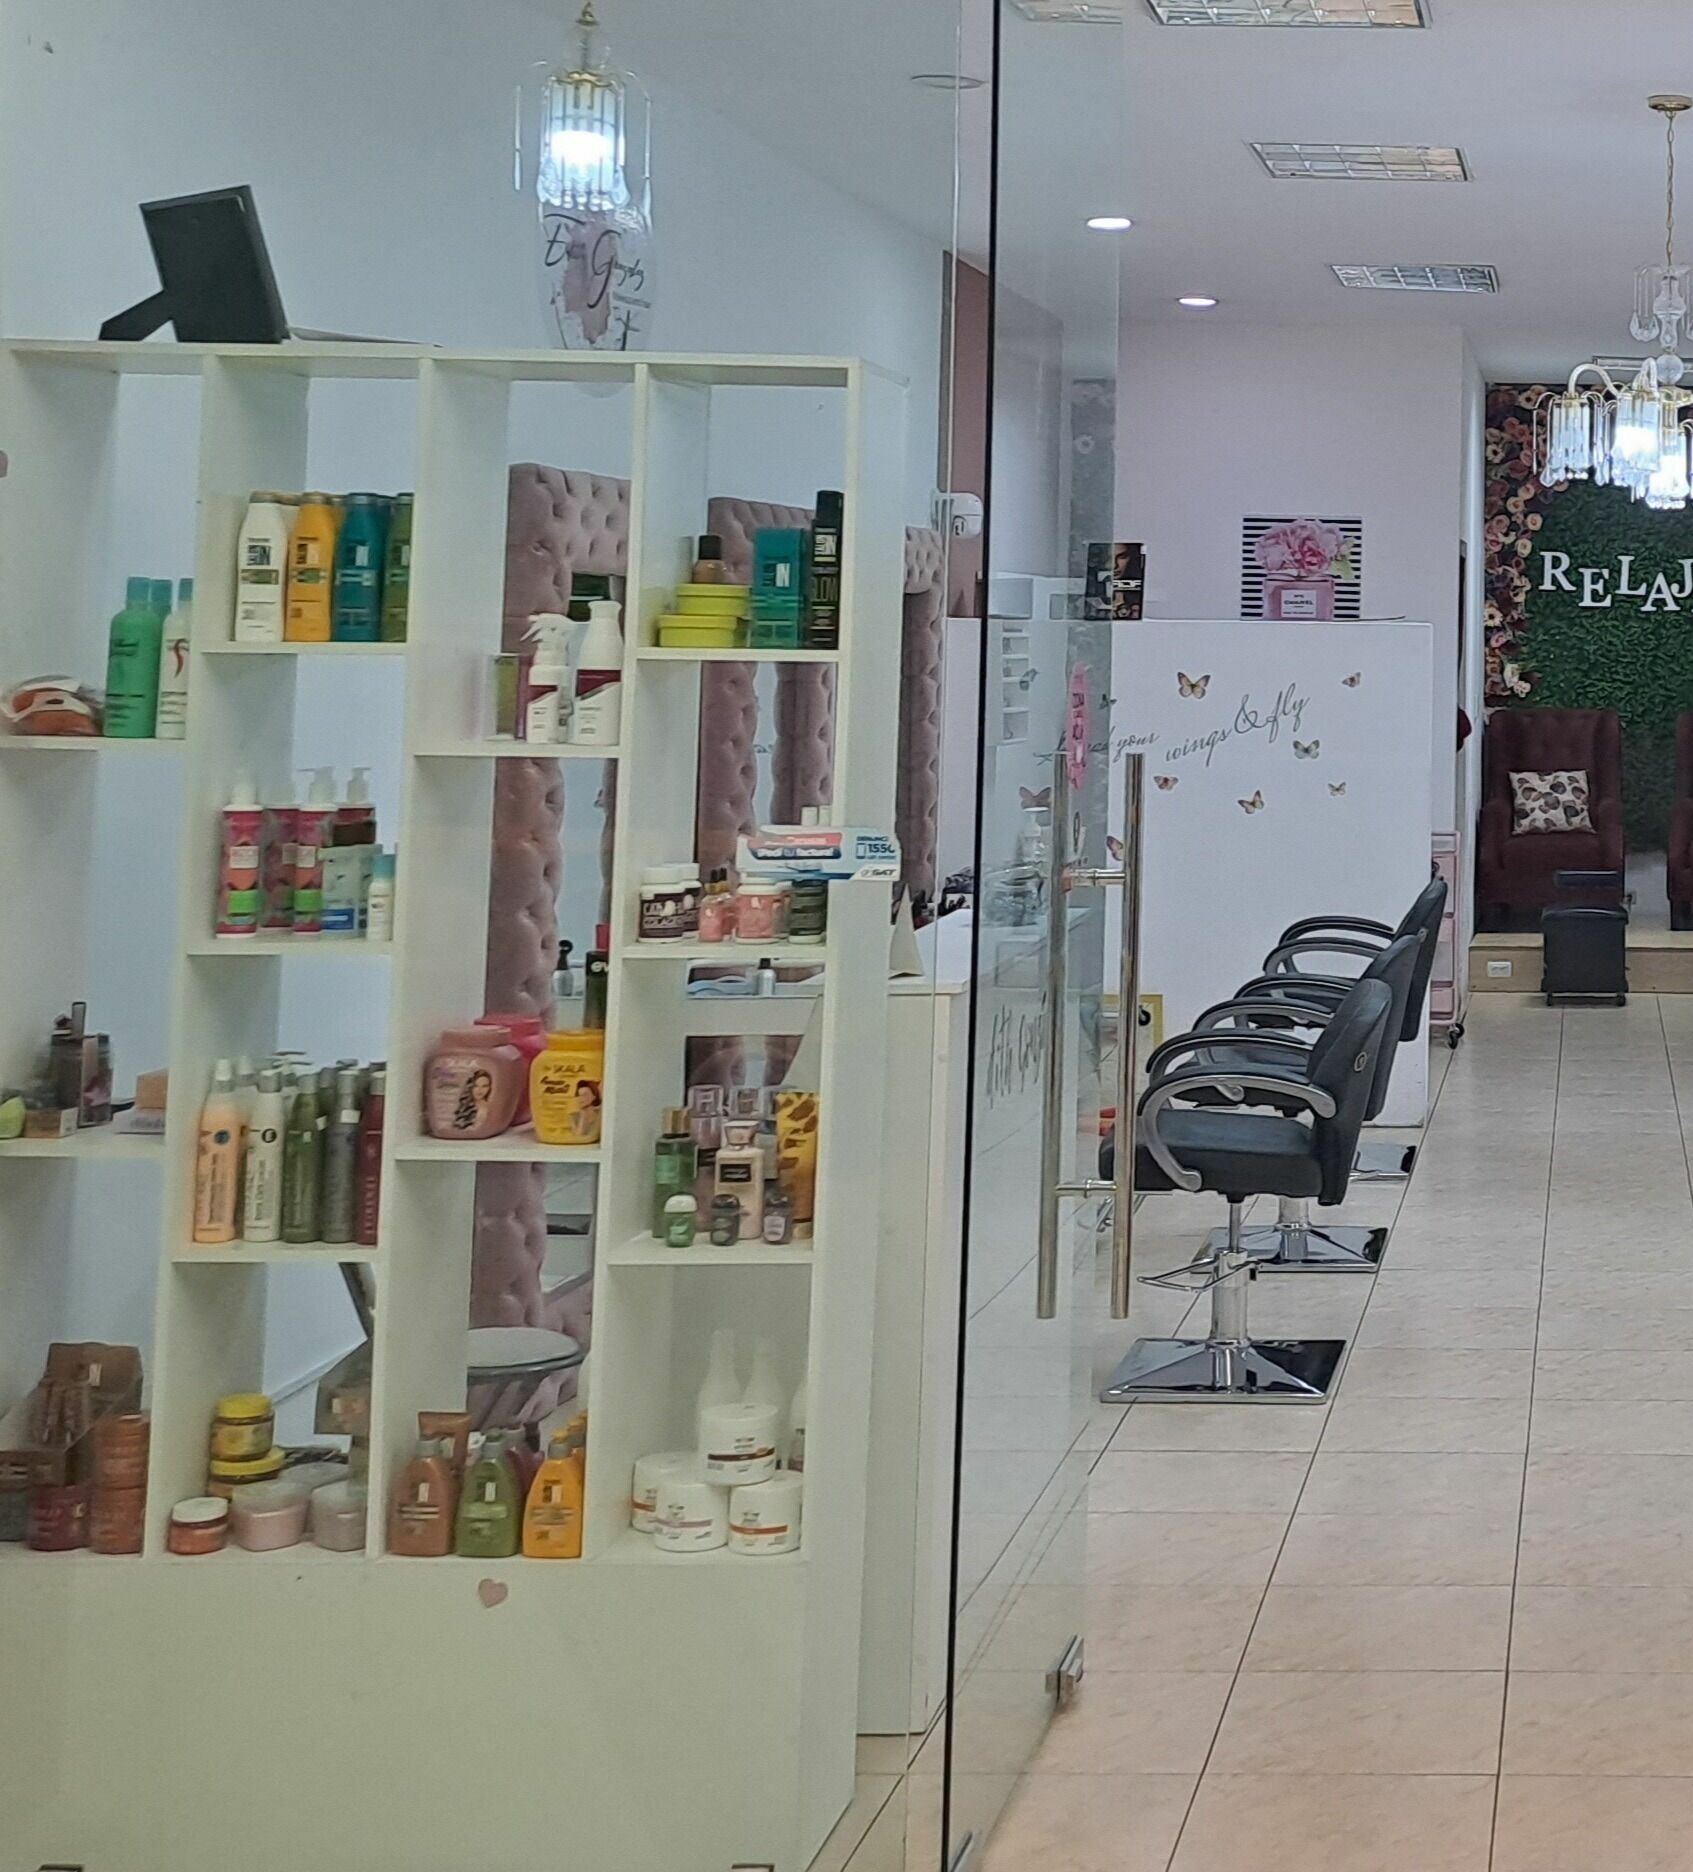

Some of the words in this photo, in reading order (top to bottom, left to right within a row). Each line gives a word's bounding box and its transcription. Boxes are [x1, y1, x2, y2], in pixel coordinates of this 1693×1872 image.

[1113, 733, 1160, 763] your
[1165, 727, 1233, 767] wings
[1233, 693, 1267, 735] &
[1264, 682, 1311, 744] fly
